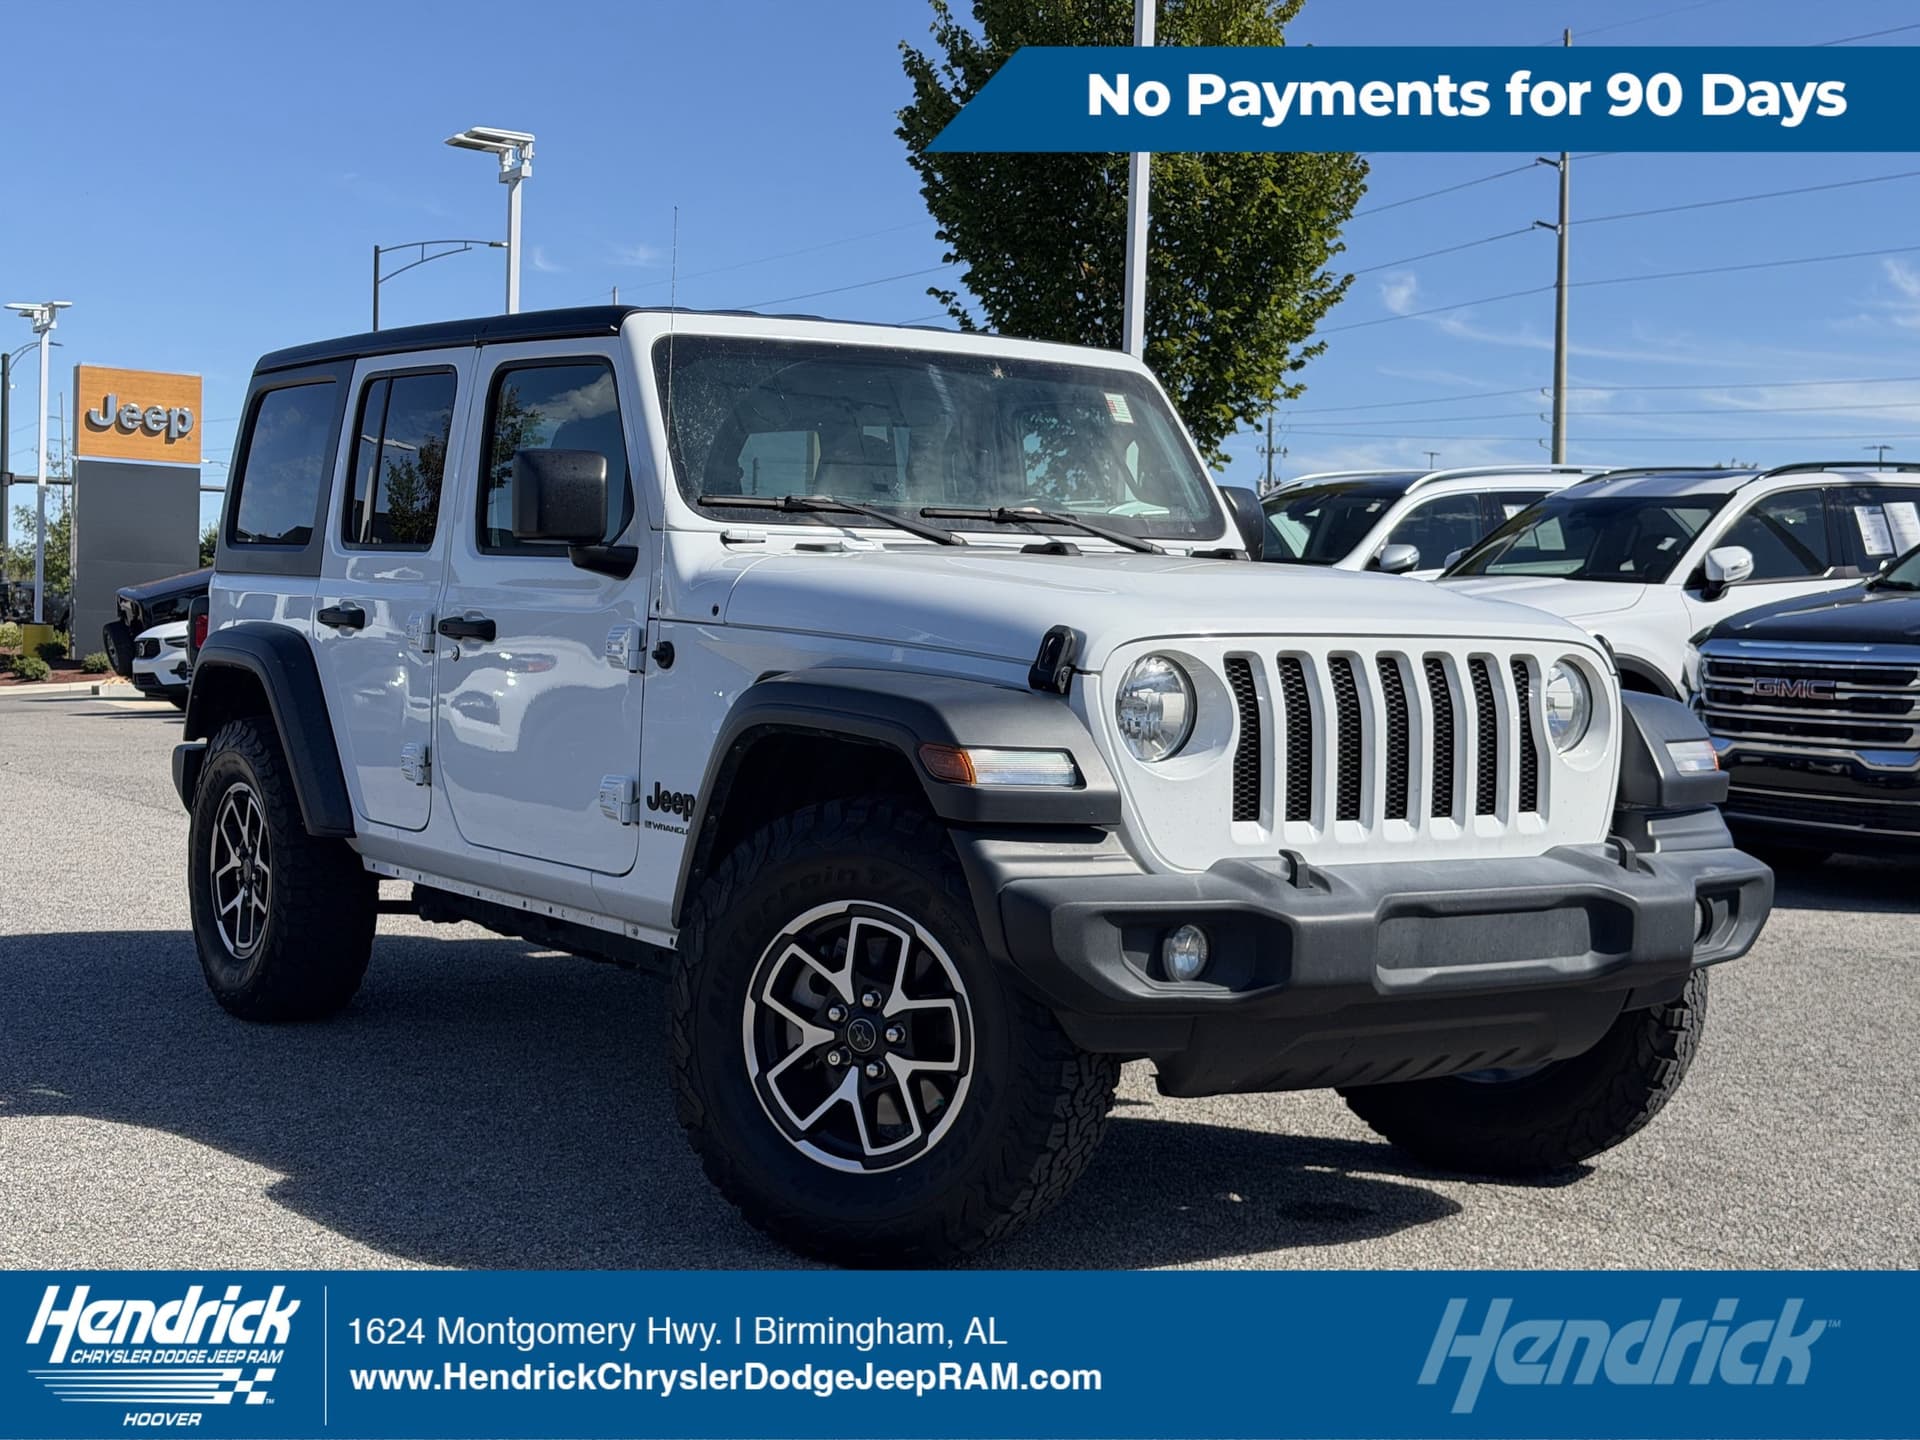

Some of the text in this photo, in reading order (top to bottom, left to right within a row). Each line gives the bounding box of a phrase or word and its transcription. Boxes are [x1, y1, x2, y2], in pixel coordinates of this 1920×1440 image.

[87, 393, 194, 440] Jeep
[1753, 677, 1836, 701] GMC
[646, 781, 697, 822] Jeep
